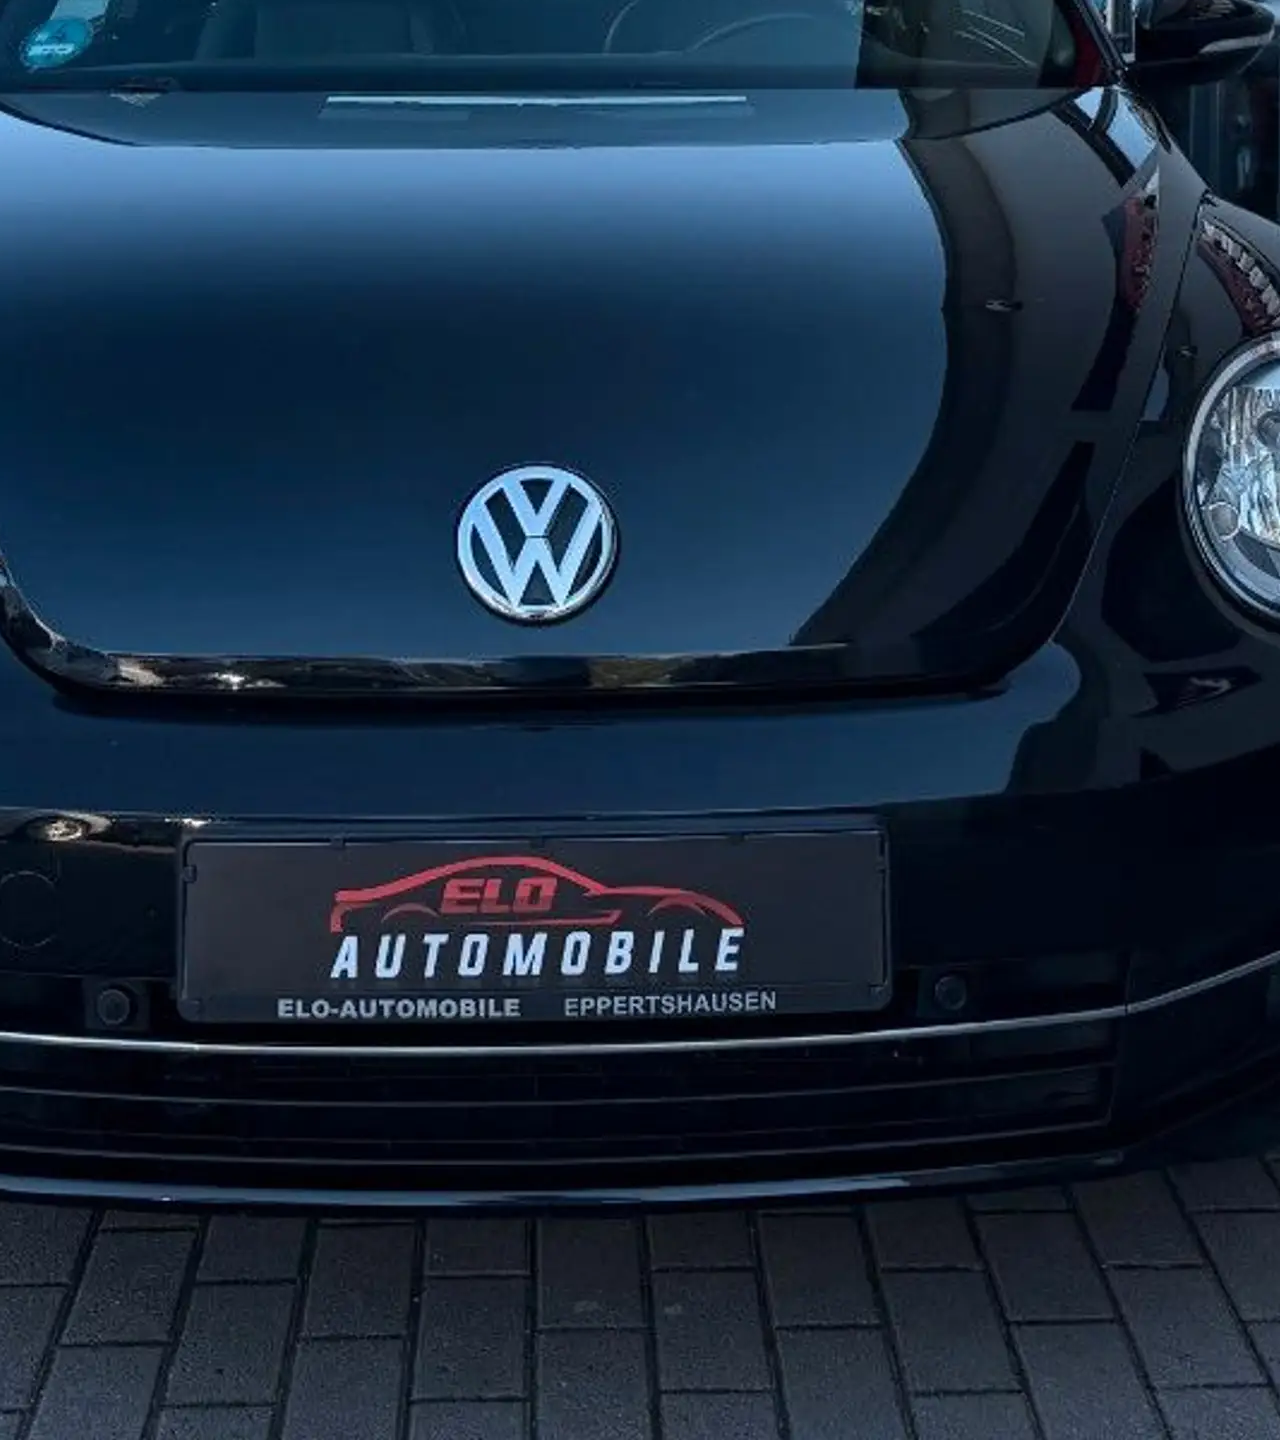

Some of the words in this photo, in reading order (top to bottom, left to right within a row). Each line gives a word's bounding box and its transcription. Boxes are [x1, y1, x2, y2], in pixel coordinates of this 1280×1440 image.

[460, 467, 612, 617] VW
[441, 877, 558, 914] ELO
[329, 927, 744, 980] AUTOMOBILE
[276, 997, 522, 1019] ELO-AUTOMOBILE
[564, 990, 777, 1018] EPPERTSHAUSEN
